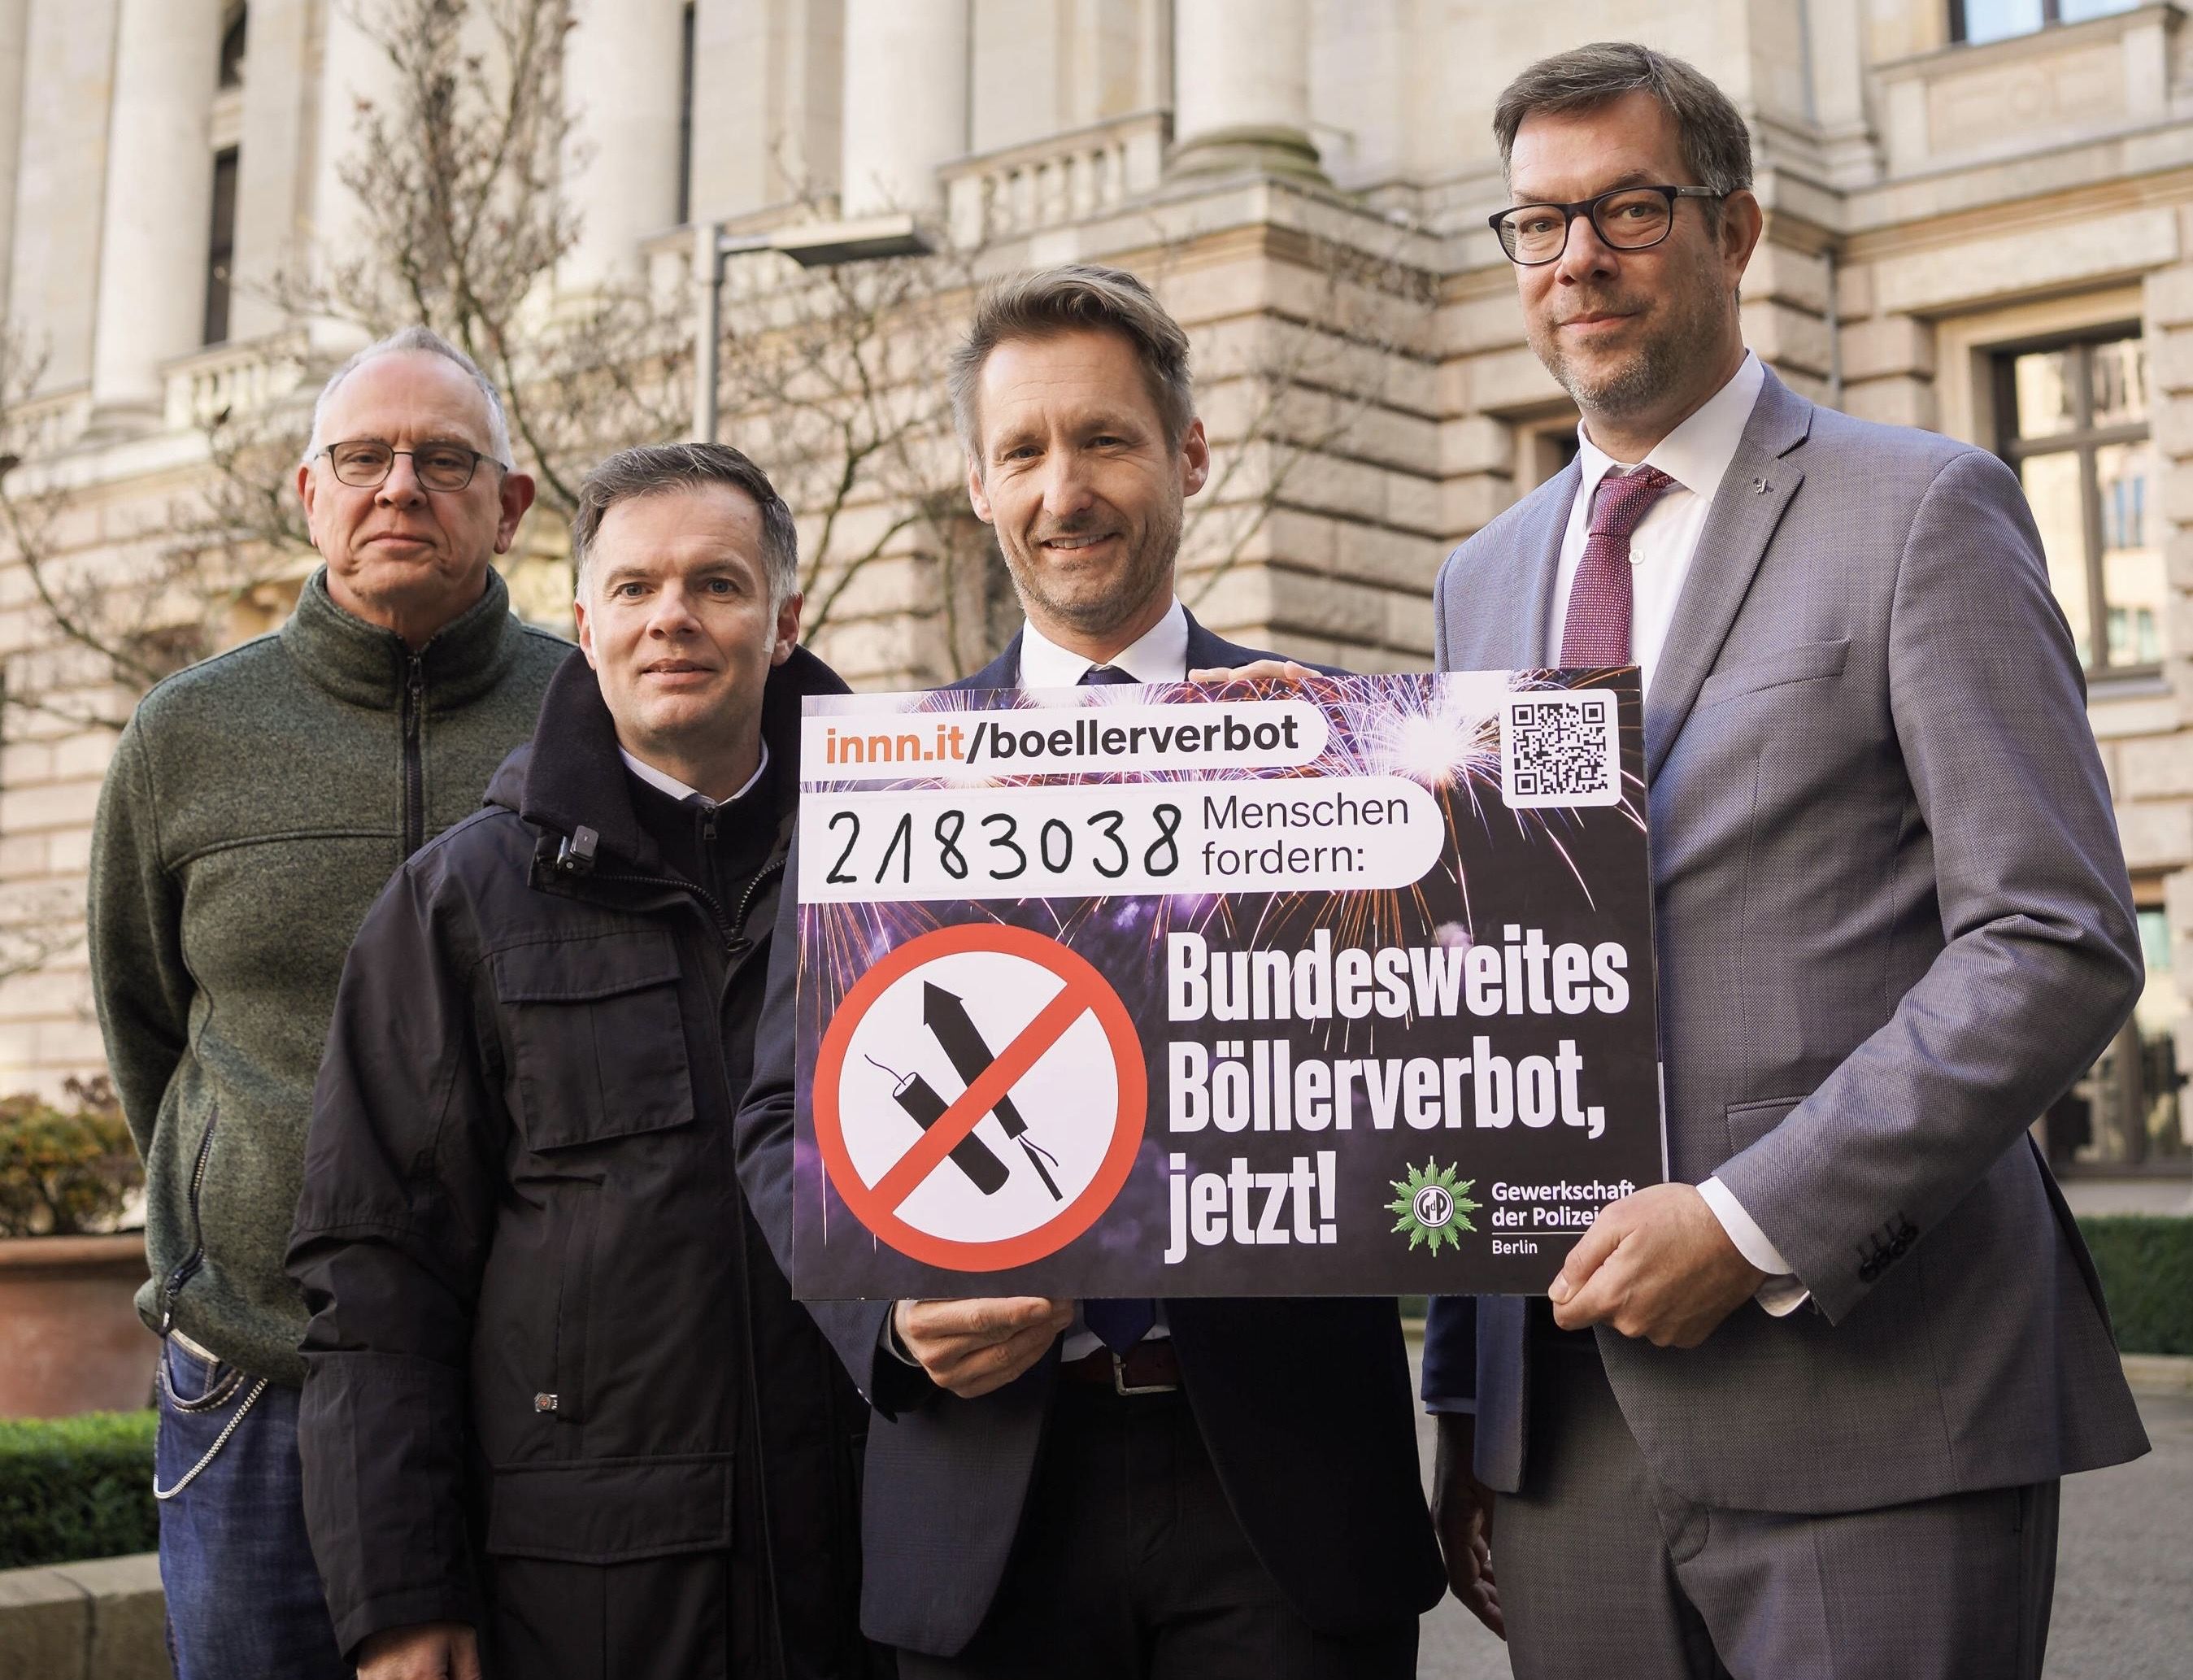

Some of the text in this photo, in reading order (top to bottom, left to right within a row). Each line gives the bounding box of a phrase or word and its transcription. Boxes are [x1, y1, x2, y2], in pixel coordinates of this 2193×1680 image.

[826, 714, 1299, 764] innn.it/boellerverbot
[1203, 792, 1409, 830] Menschen
[826, 803, 1182, 884] 2183038
[1202, 841, 1365, 876] fordern:
[1168, 924, 1630, 1022] Bundesweites
[1168, 1035, 1605, 1140] Böllerverbot,
[1164, 1151, 1338, 1264] jetzt!
[1491, 1179, 1636, 1201] Gewerkschaft
[1491, 1208, 1528, 1227] der
[1492, 1240, 1538, 1255] Berlin
